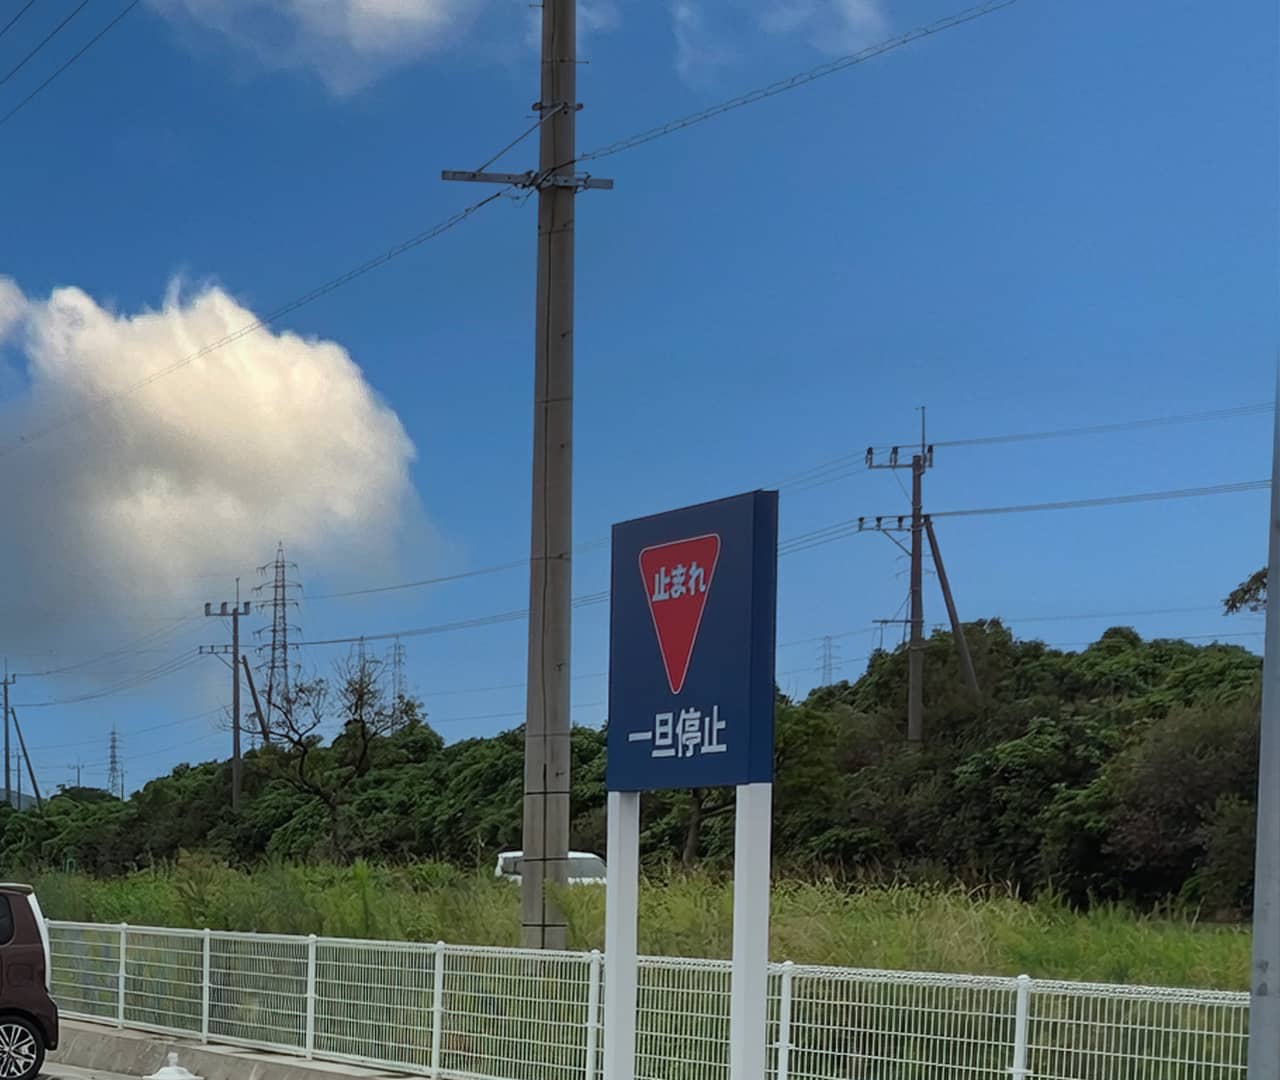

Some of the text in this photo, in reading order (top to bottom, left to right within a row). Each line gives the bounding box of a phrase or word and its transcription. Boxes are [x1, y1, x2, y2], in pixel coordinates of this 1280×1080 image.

[651, 560, 707, 602] 止まれ
[628, 705, 727, 758] 一旦停止
